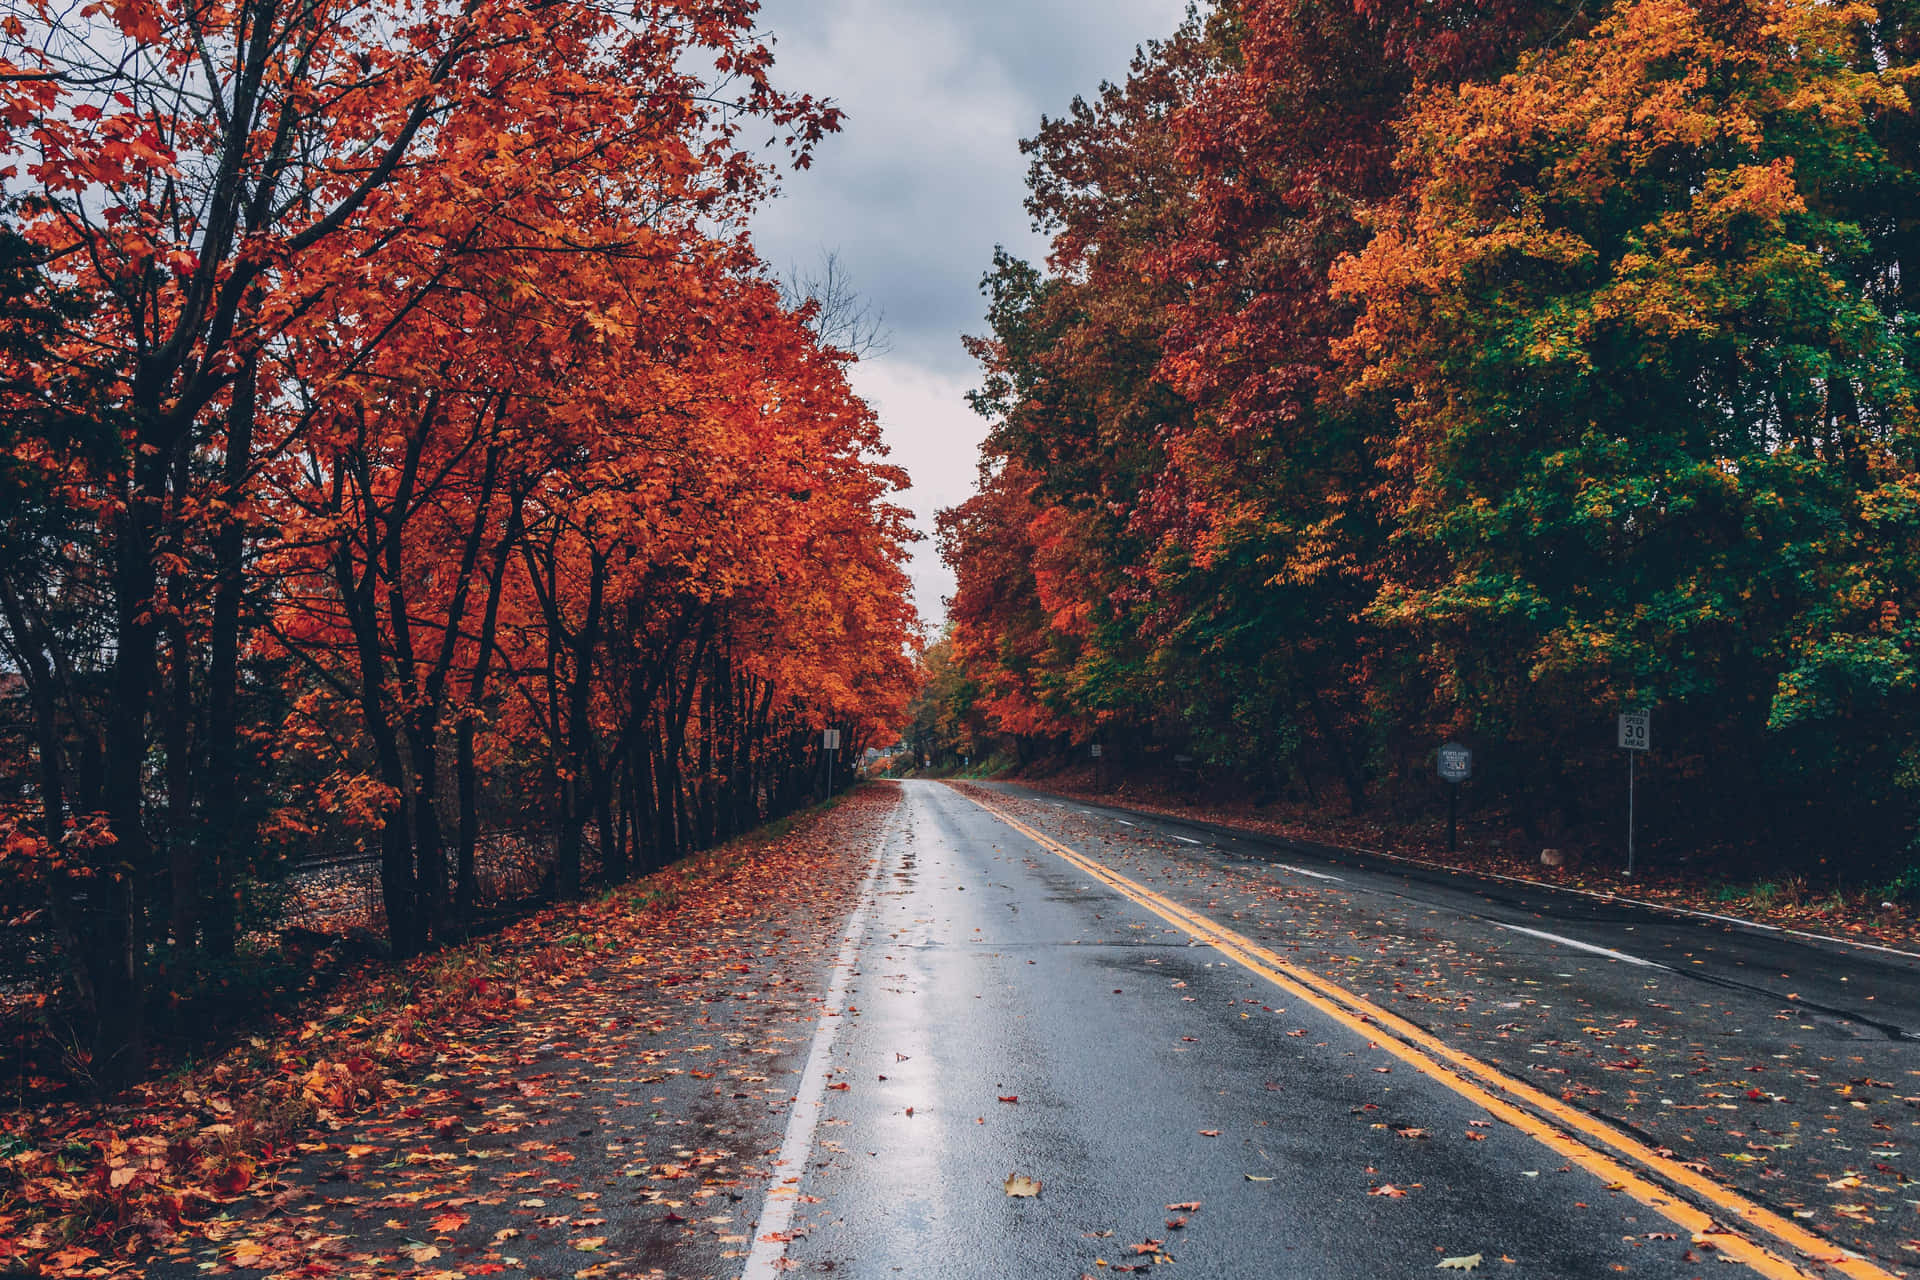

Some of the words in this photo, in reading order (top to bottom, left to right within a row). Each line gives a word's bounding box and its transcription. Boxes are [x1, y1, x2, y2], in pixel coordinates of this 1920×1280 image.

[1625, 717, 1644, 725] SPEED
[1626, 725, 1644, 738] 30
[1624, 738, 1644, 746] AHEAD
